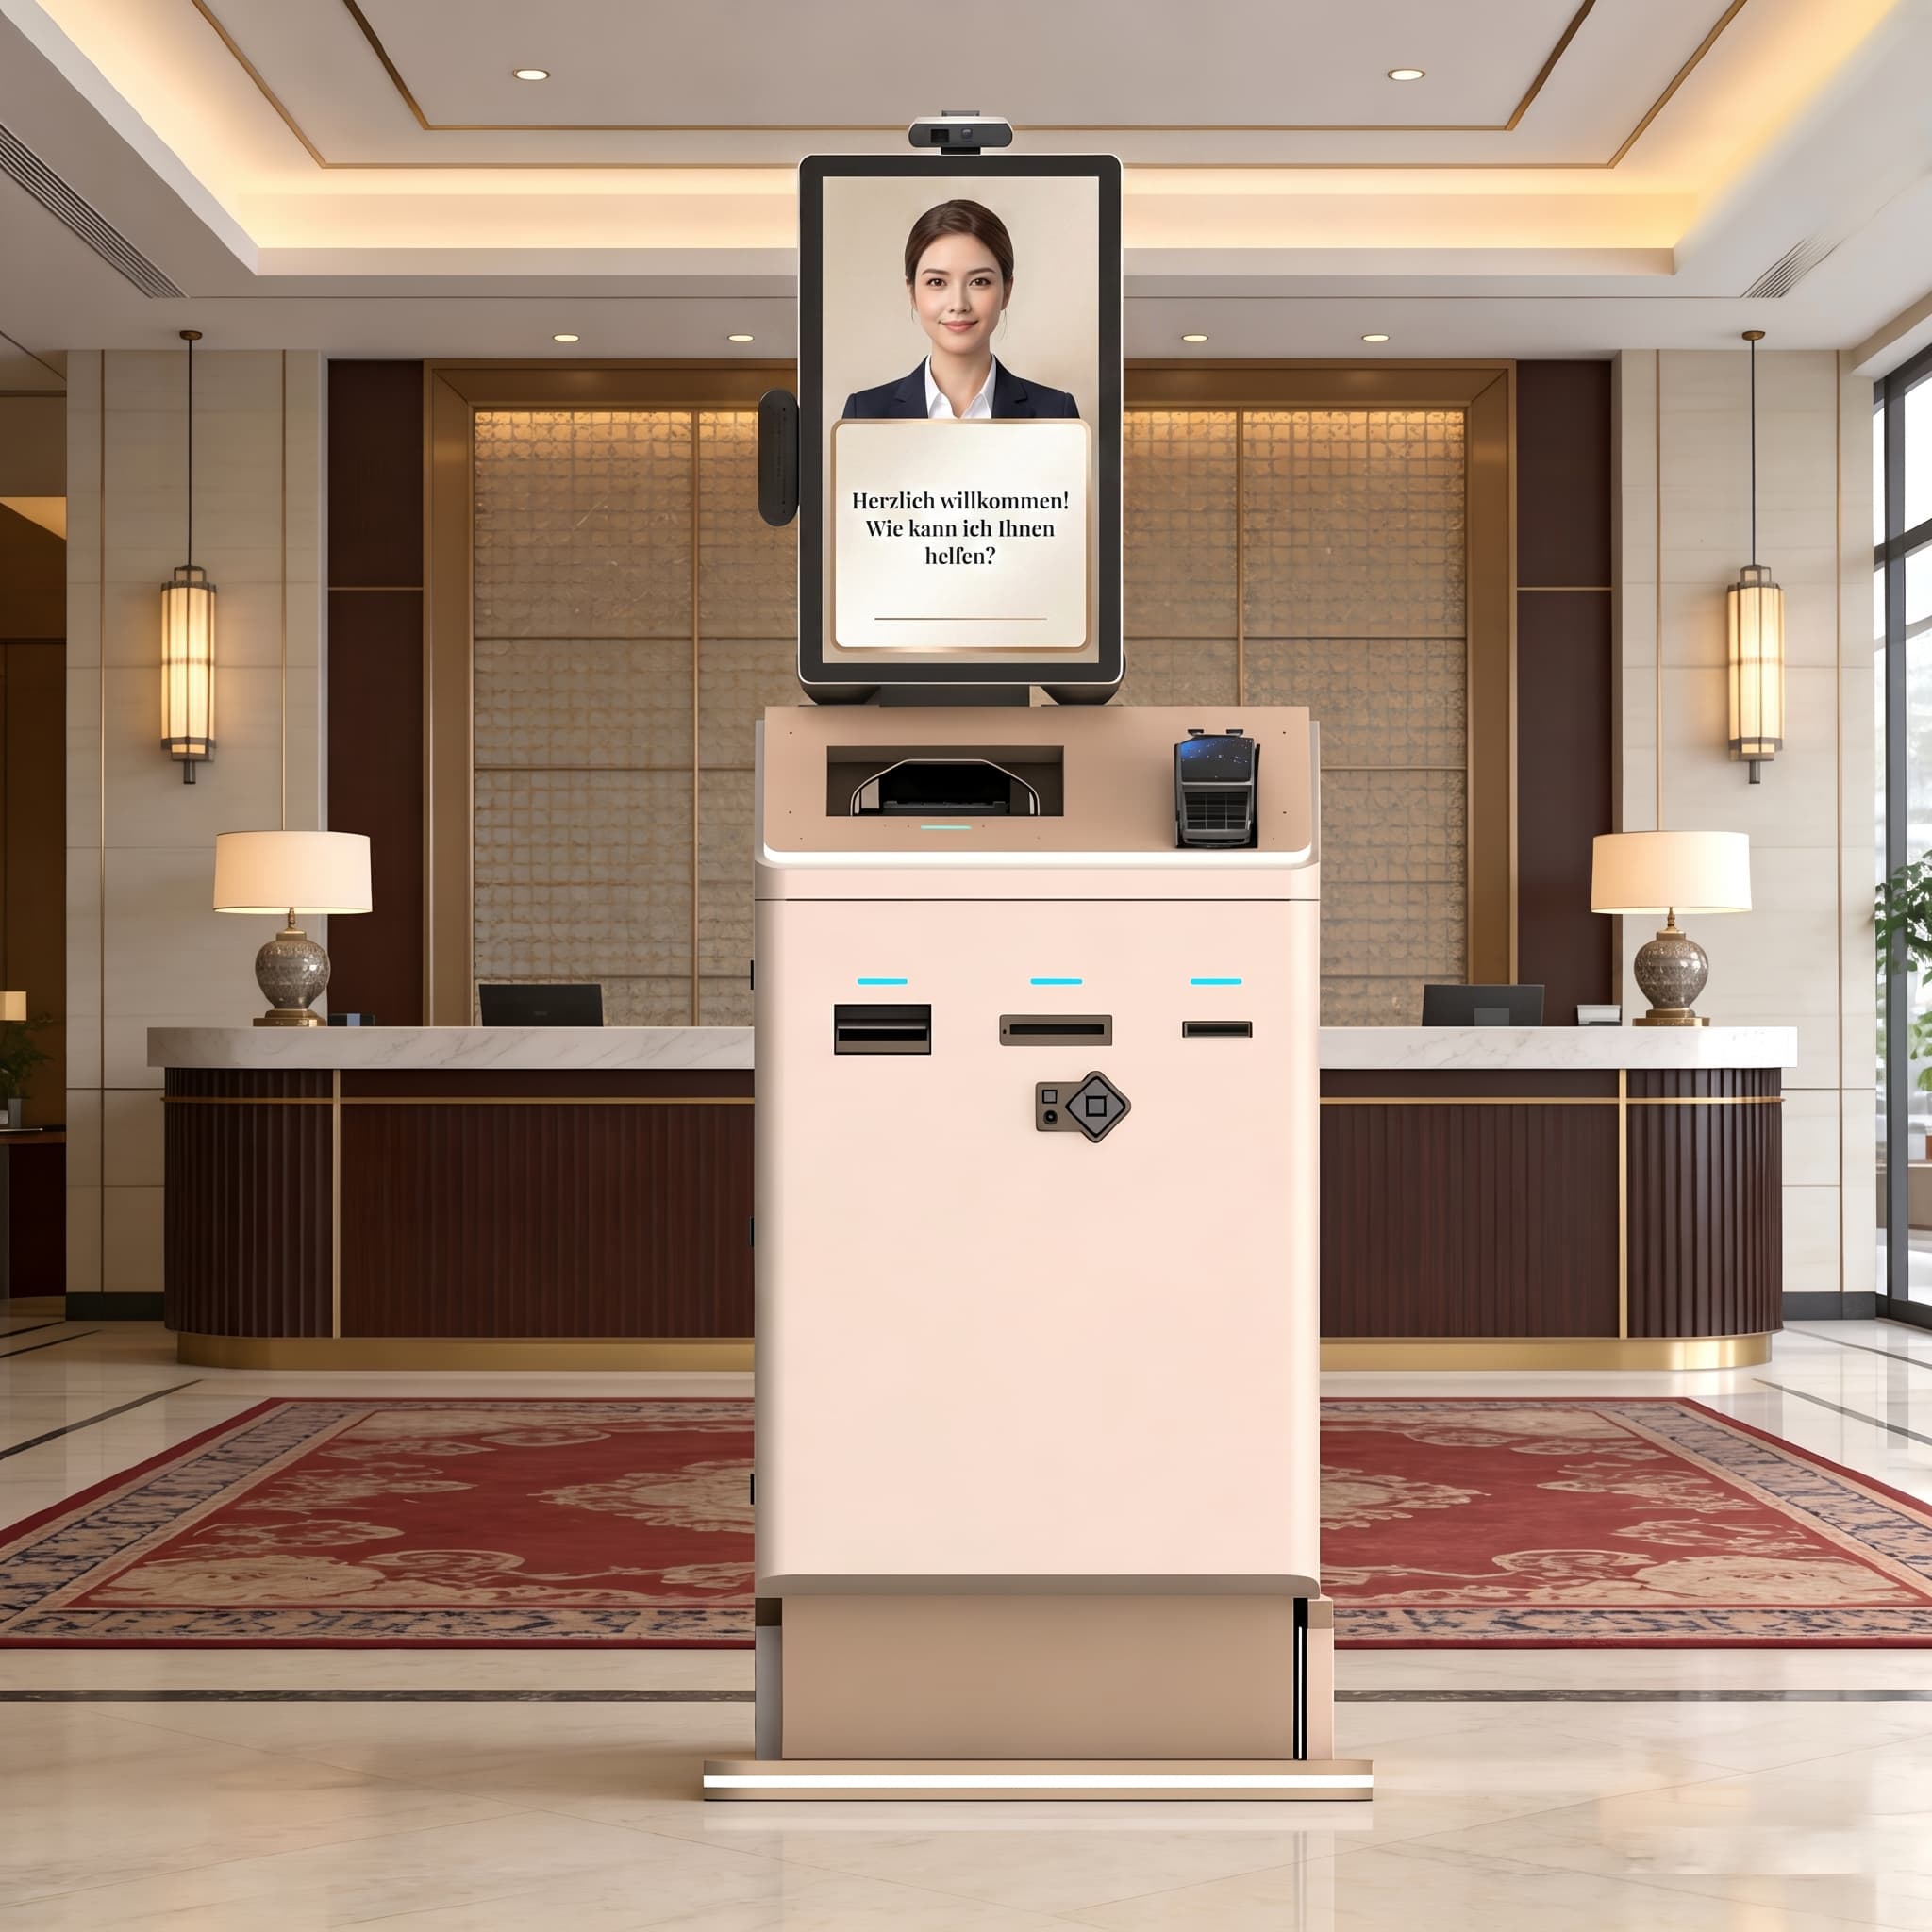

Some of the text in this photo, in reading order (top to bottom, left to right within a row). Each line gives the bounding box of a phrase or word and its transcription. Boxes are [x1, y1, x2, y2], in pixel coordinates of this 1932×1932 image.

[852, 491, 1069, 509] Herzlich willkommen!
[866, 519, 1055, 537] Wie kann ich Ihnen
[925, 546, 996, 565] helfen?
